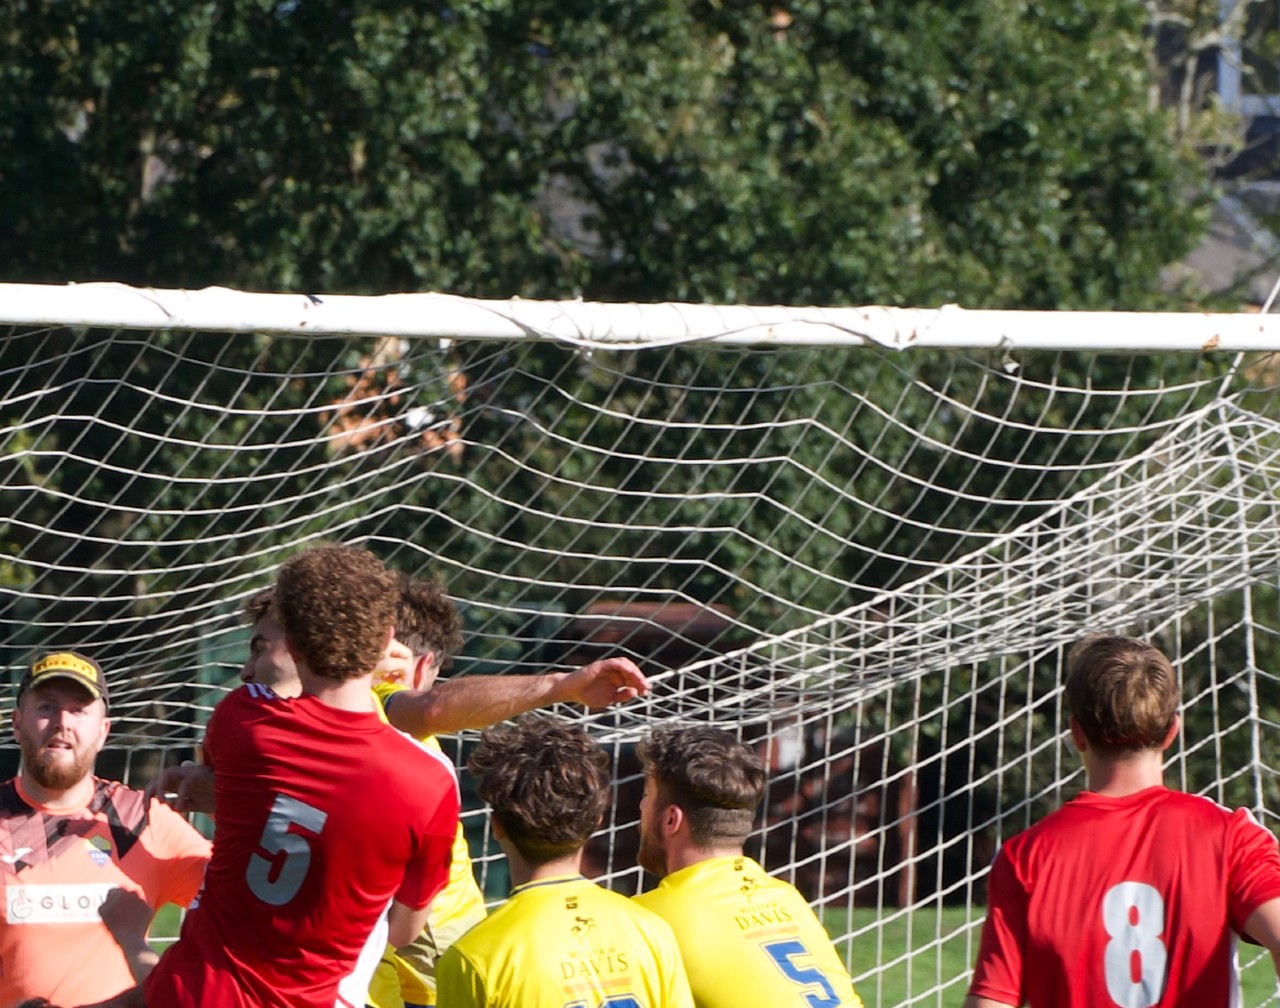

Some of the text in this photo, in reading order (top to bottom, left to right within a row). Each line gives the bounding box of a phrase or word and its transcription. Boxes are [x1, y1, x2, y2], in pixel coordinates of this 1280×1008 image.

[246, 792, 328, 906] 5
[734, 907, 793, 930] DAVIS
[560, 953, 629, 980] DAVIS
